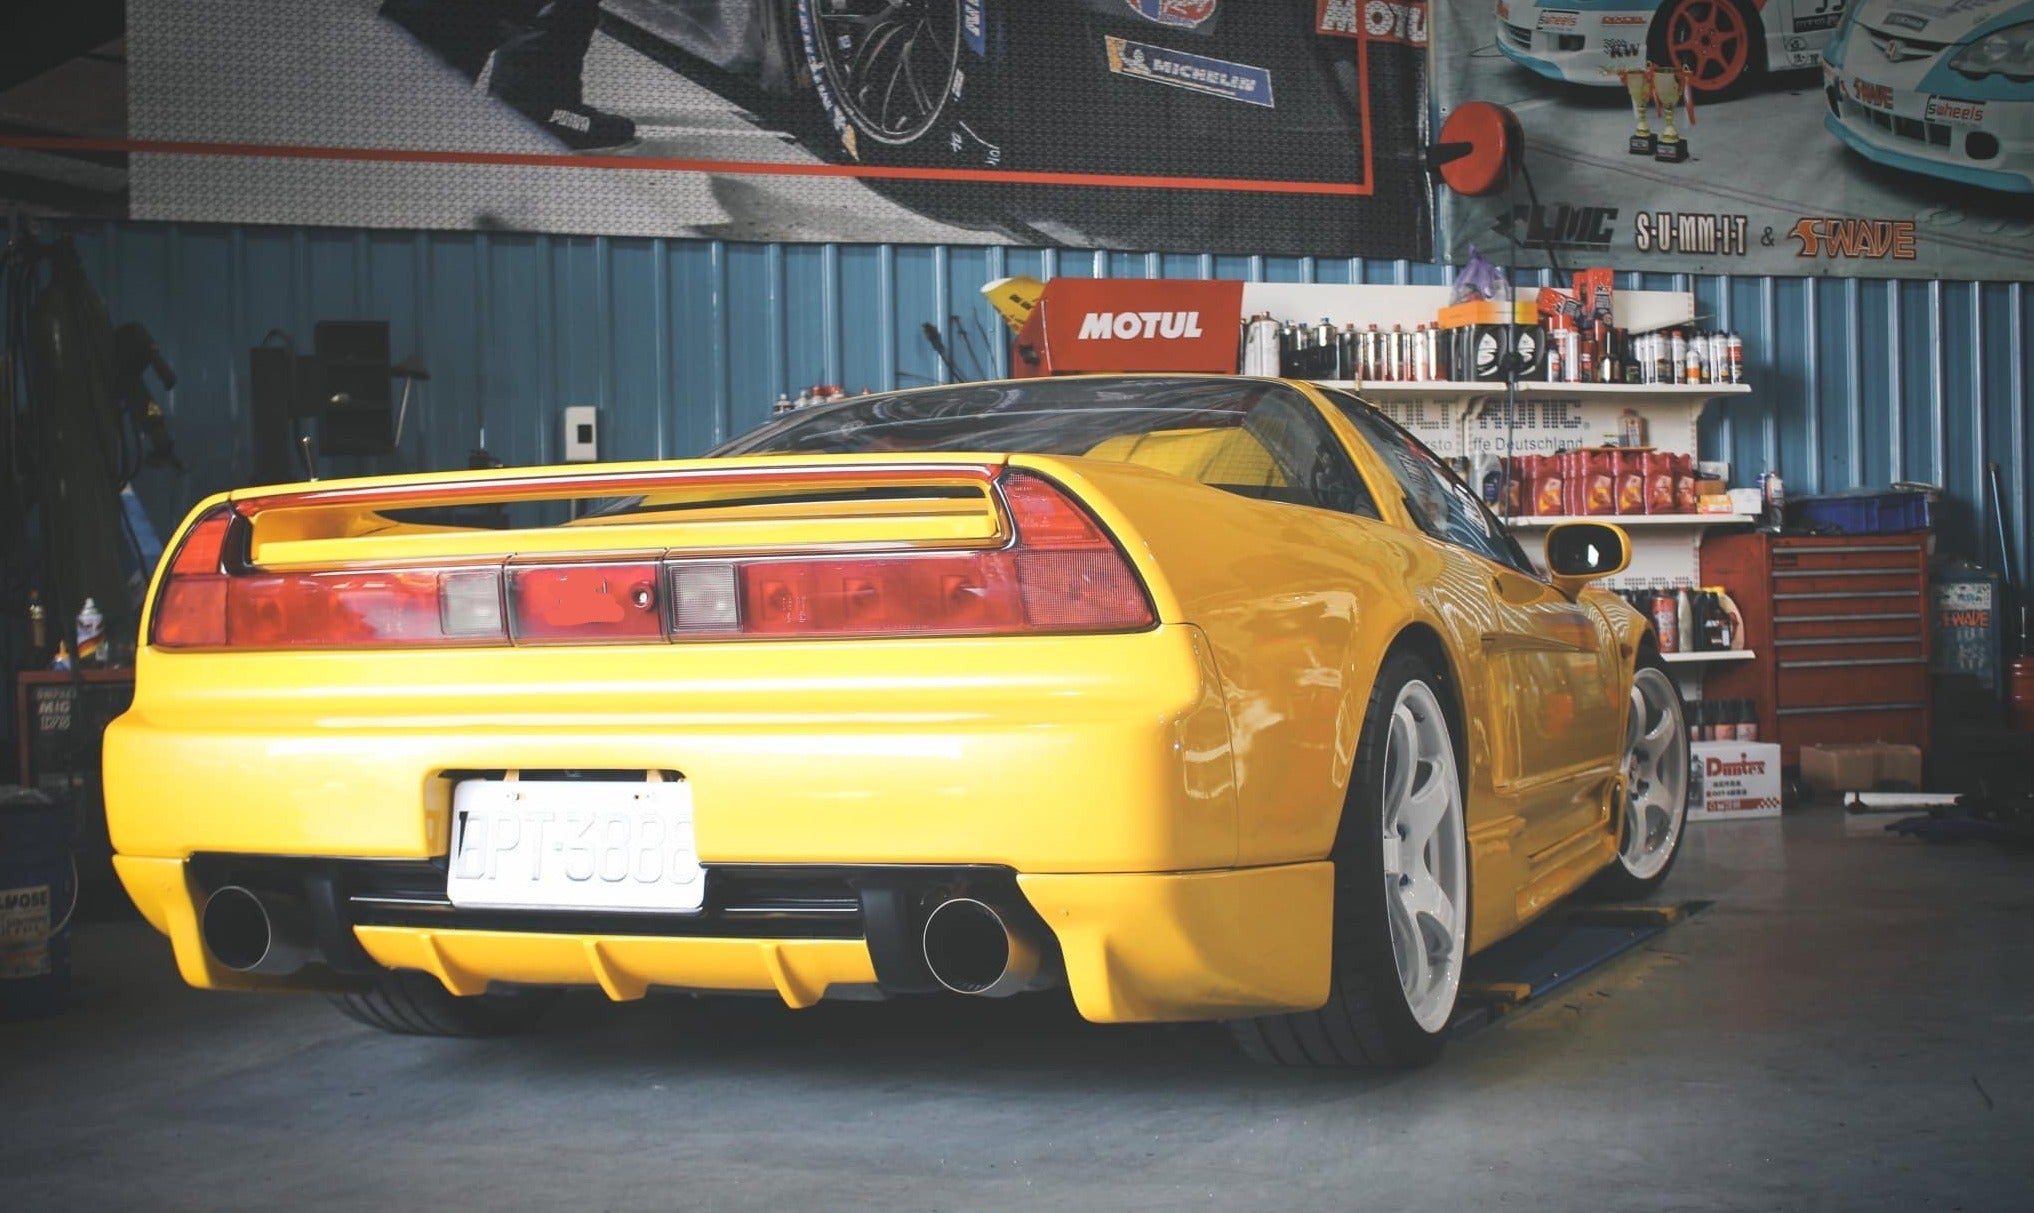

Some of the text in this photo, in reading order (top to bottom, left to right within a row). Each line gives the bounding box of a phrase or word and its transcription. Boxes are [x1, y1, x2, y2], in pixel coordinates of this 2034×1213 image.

[1153, 58, 1256, 92] MICHELIN
[1761, 226, 1775, 247] &
[1078, 311, 1203, 340] MOTUL
